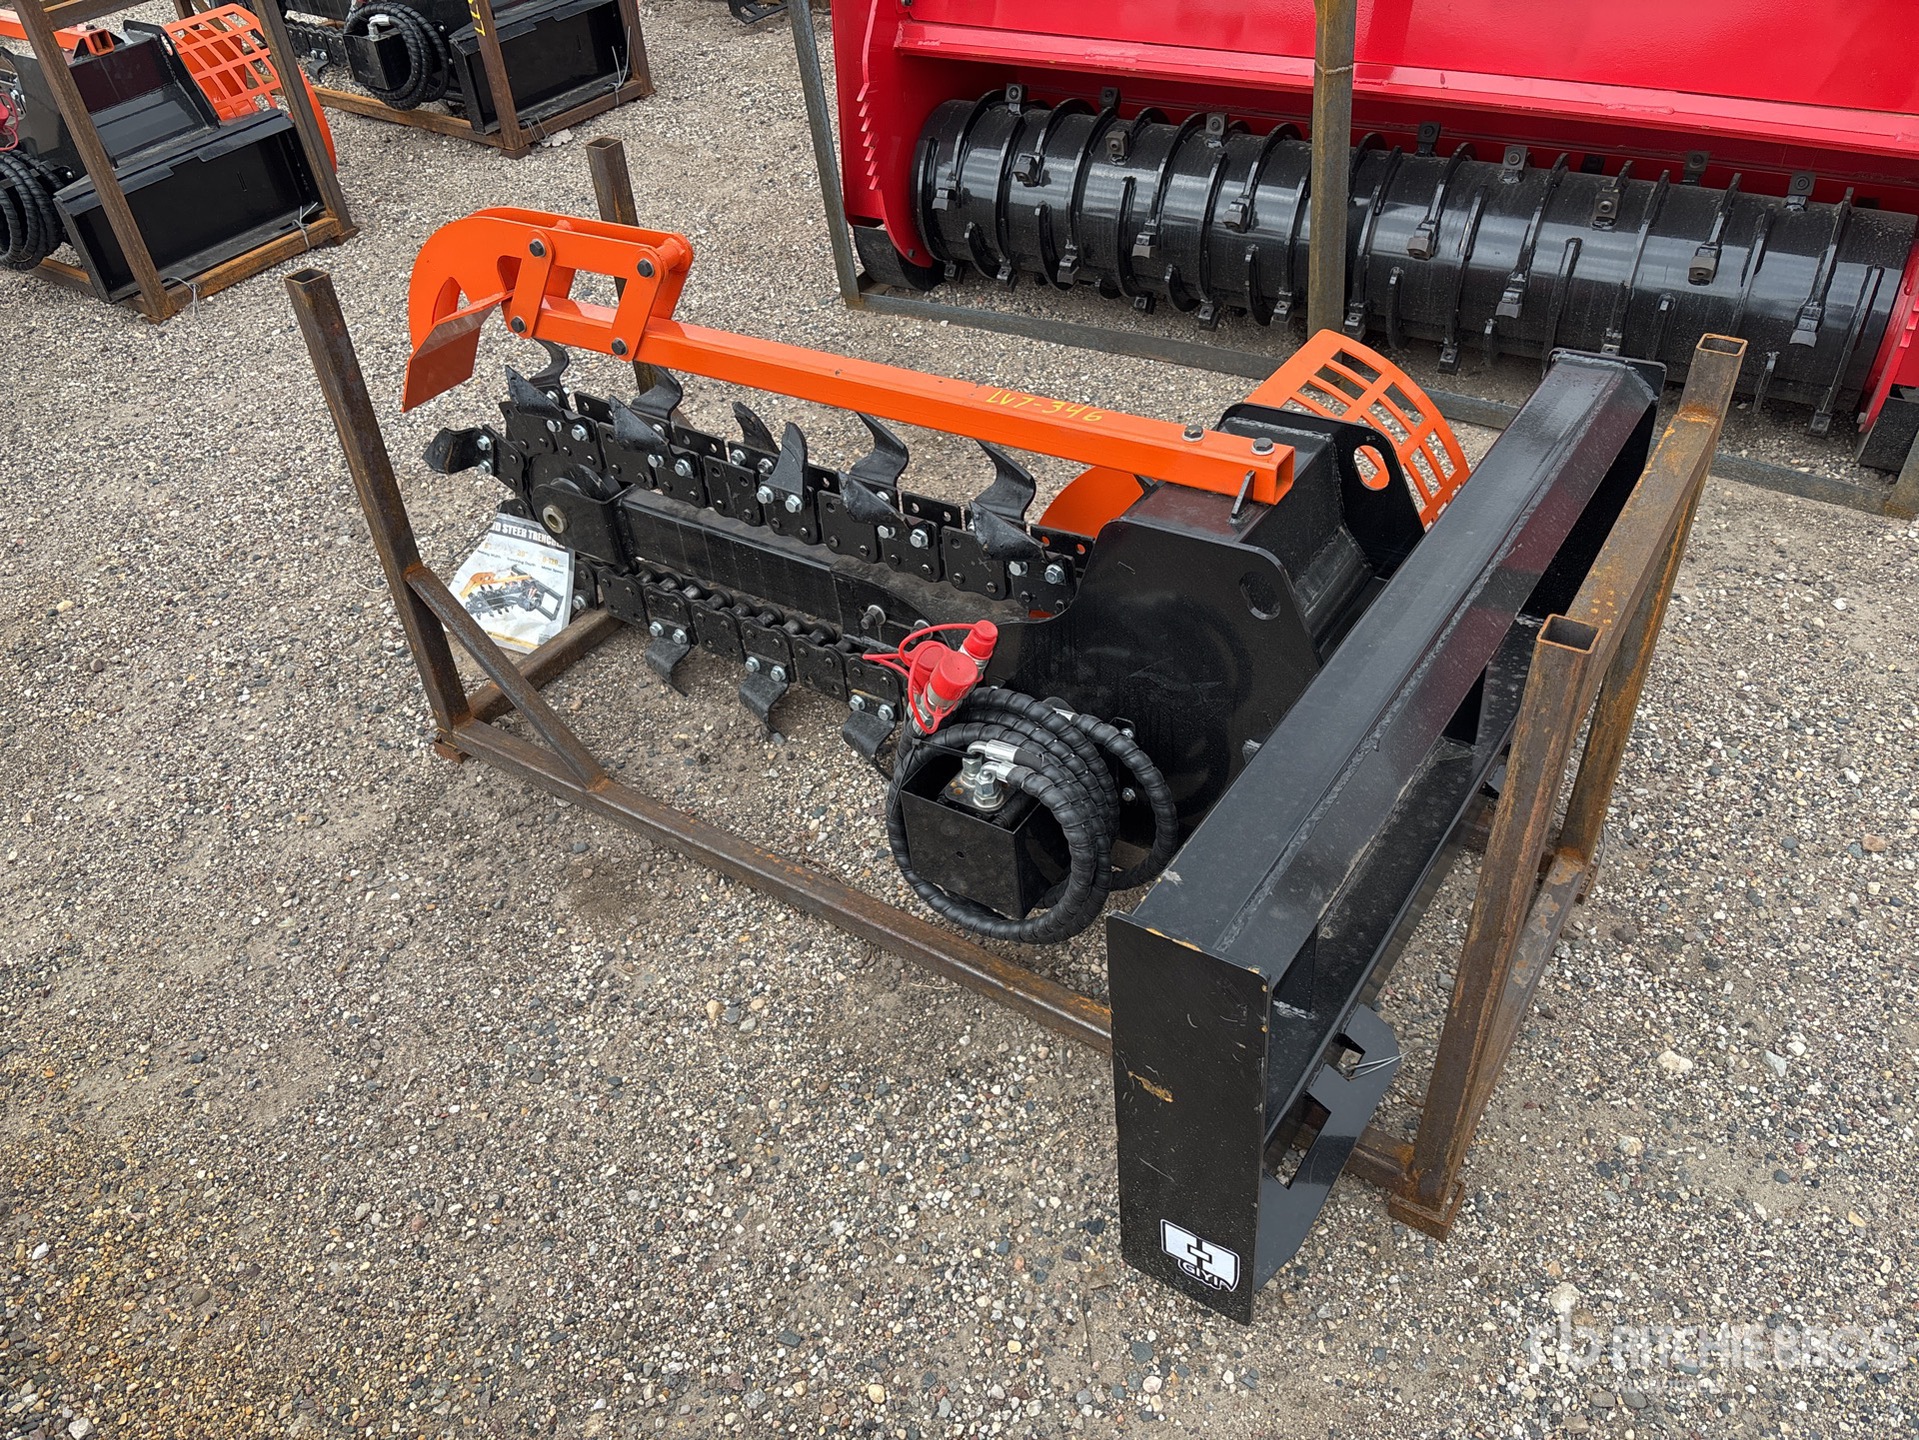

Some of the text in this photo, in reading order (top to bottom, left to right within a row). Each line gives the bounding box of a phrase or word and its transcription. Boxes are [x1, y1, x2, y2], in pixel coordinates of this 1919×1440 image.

[985, 389, 1104, 422] LV7-346
[501, 524, 528, 538] STEER
[1182, 1261, 1219, 1287] GIYI
